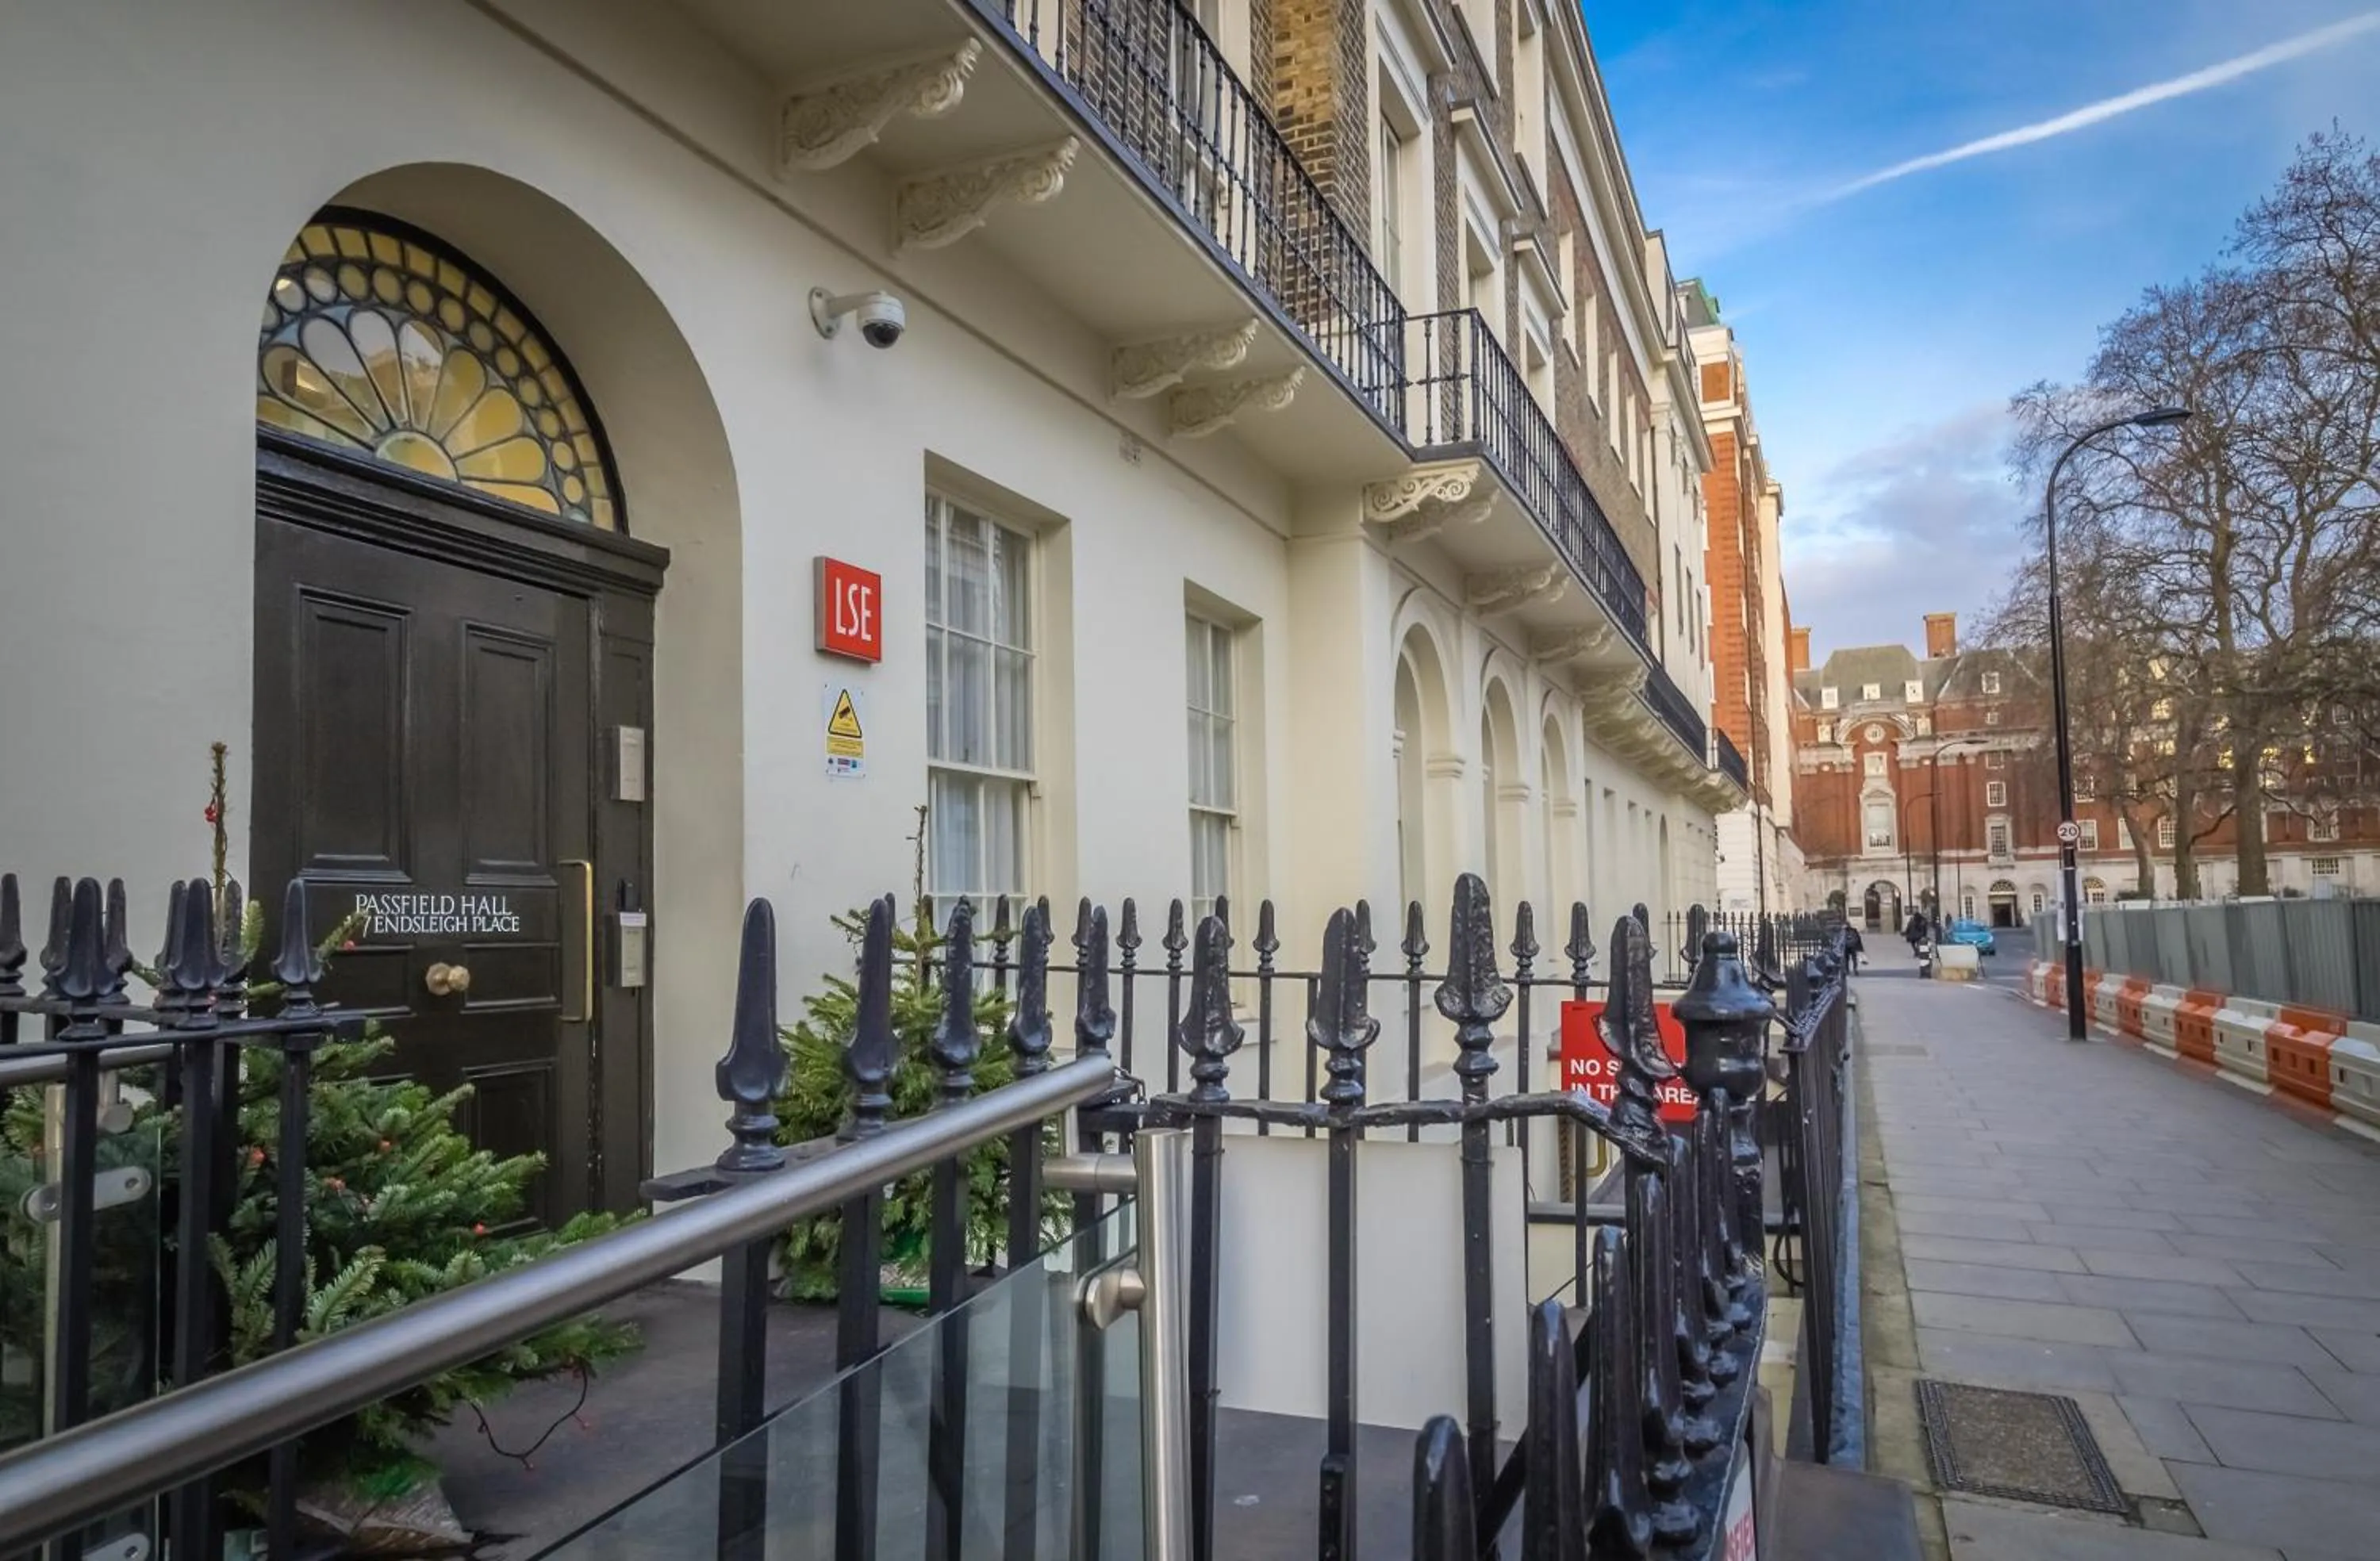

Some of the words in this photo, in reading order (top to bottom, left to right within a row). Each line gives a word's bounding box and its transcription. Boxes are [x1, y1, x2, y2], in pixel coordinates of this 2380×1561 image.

[835, 577, 872, 642] LSE
[2059, 827, 2077, 837] 20
[355, 894, 455, 915] PASSFIELD
[461, 895, 512, 915] HALL
[374, 915, 467, 933] ENDSLEIGH
[473, 916, 520, 932] PLACE
[1571, 1059, 1601, 1076] NO
